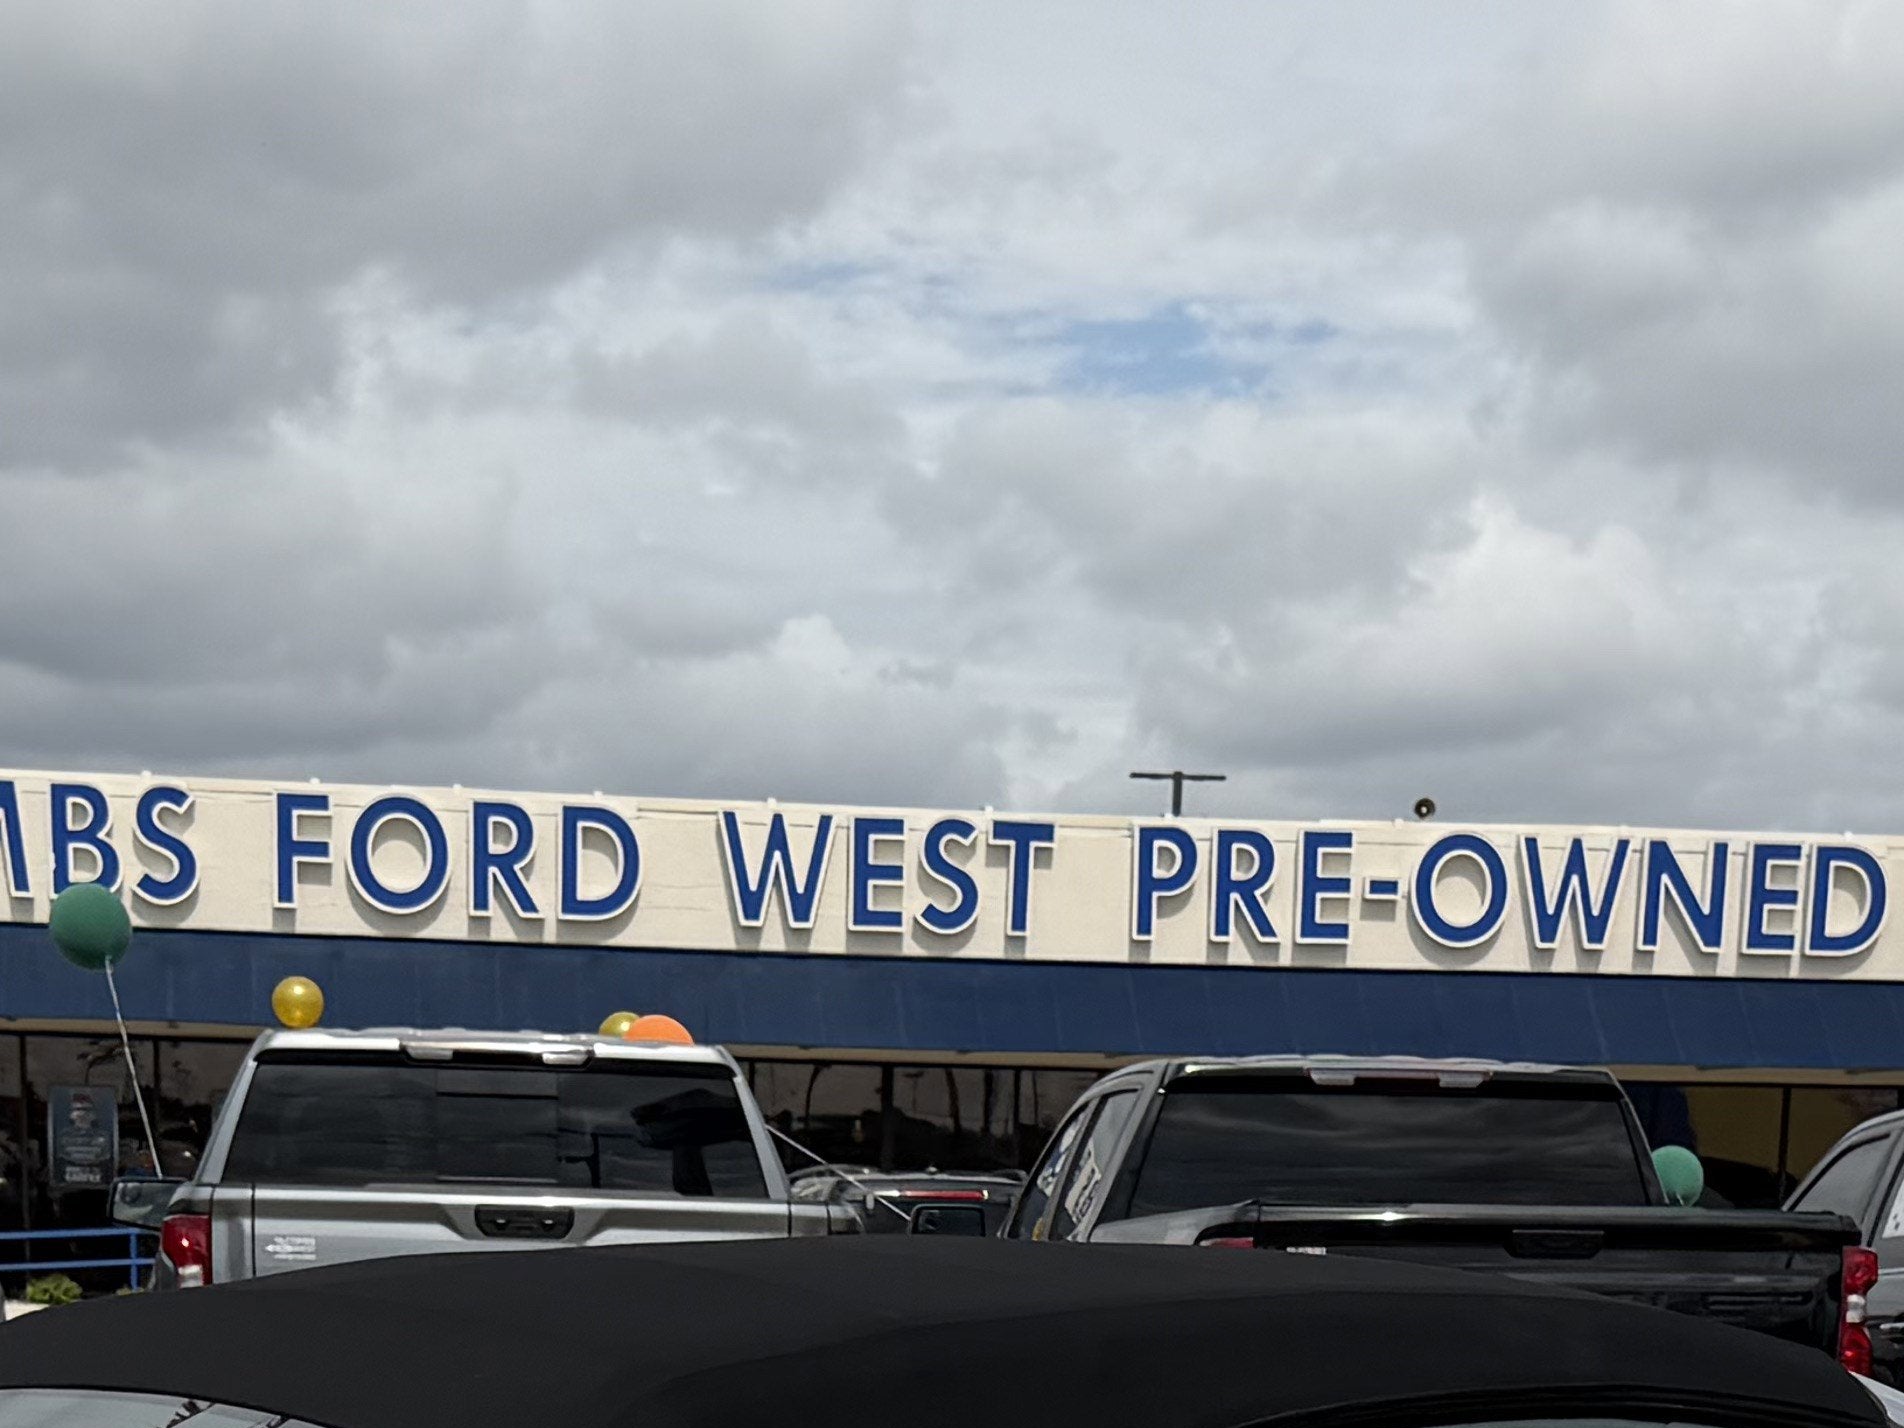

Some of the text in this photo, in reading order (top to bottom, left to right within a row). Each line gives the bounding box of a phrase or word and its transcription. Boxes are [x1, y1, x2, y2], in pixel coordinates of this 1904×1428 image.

[273, 793, 643, 922] FORD
[717, 809, 1056, 939] WEST
[1131, 825, 1890, 960] PRE-OWNED
